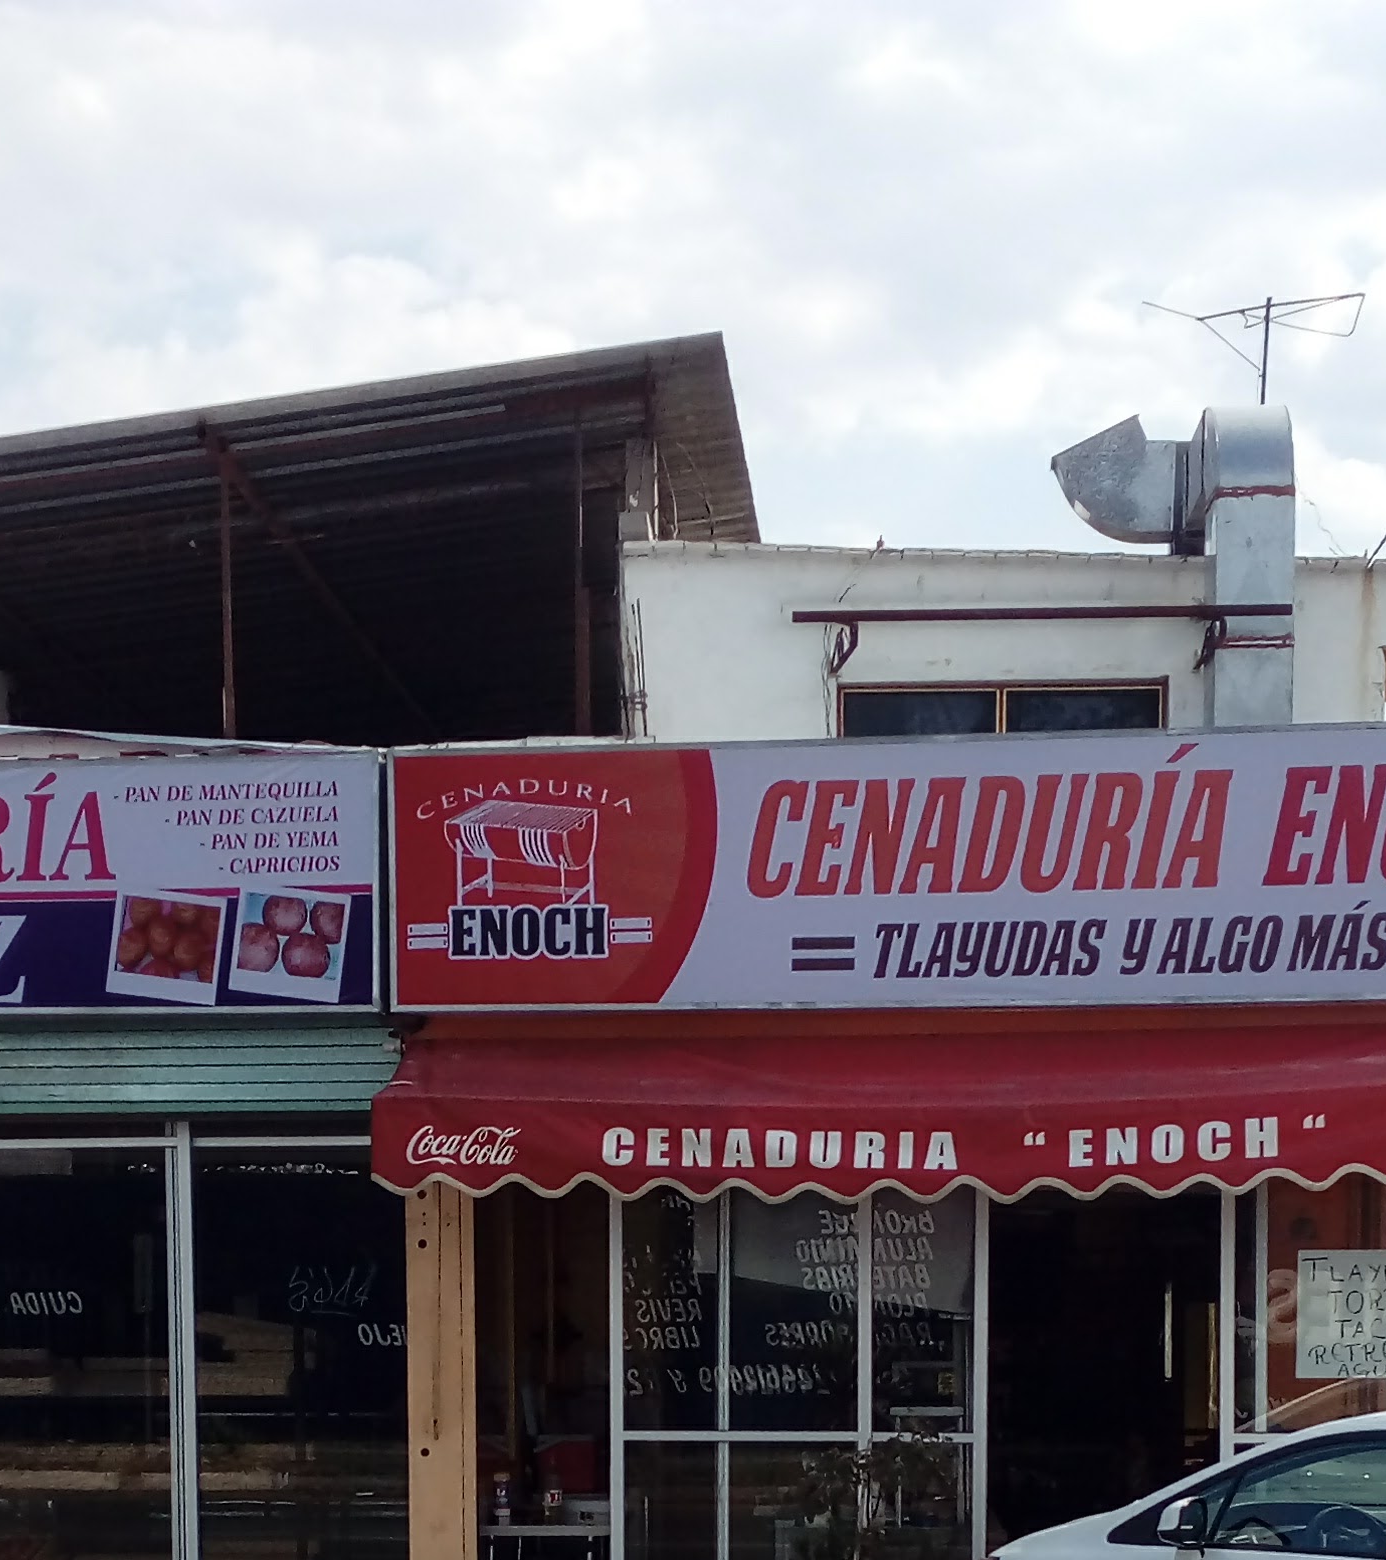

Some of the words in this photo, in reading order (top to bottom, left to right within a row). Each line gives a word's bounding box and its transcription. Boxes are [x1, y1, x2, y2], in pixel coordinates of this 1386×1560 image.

[124, 785, 159, 803] PAN
[166, 784, 193, 802] DE
[198, 780, 339, 802] MANTEQUILLA
[415, 777, 635, 820] CENADURIA
[176, 808, 212, 827] PAN
[217, 807, 245, 826] DE
[249, 805, 339, 825] CAZUELA
[745, 743, 1235, 899] CENADURÍA
[211, 832, 249, 852] PAN
[254, 831, 281, 851] DE
[286, 829, 339, 850] YEMA
[229, 854, 341, 875] CAPRICHOS
[448, 904, 609, 960] ENOCH
[873, 917, 1108, 980] TLAYUDAS
[1156, 914, 1283, 976] ALGO
[405, 1124, 520, 1167] Coca-Cola
[601, 1126, 959, 1171] CENADURIA
[1068, 1116, 1280, 1168] ENOCH
